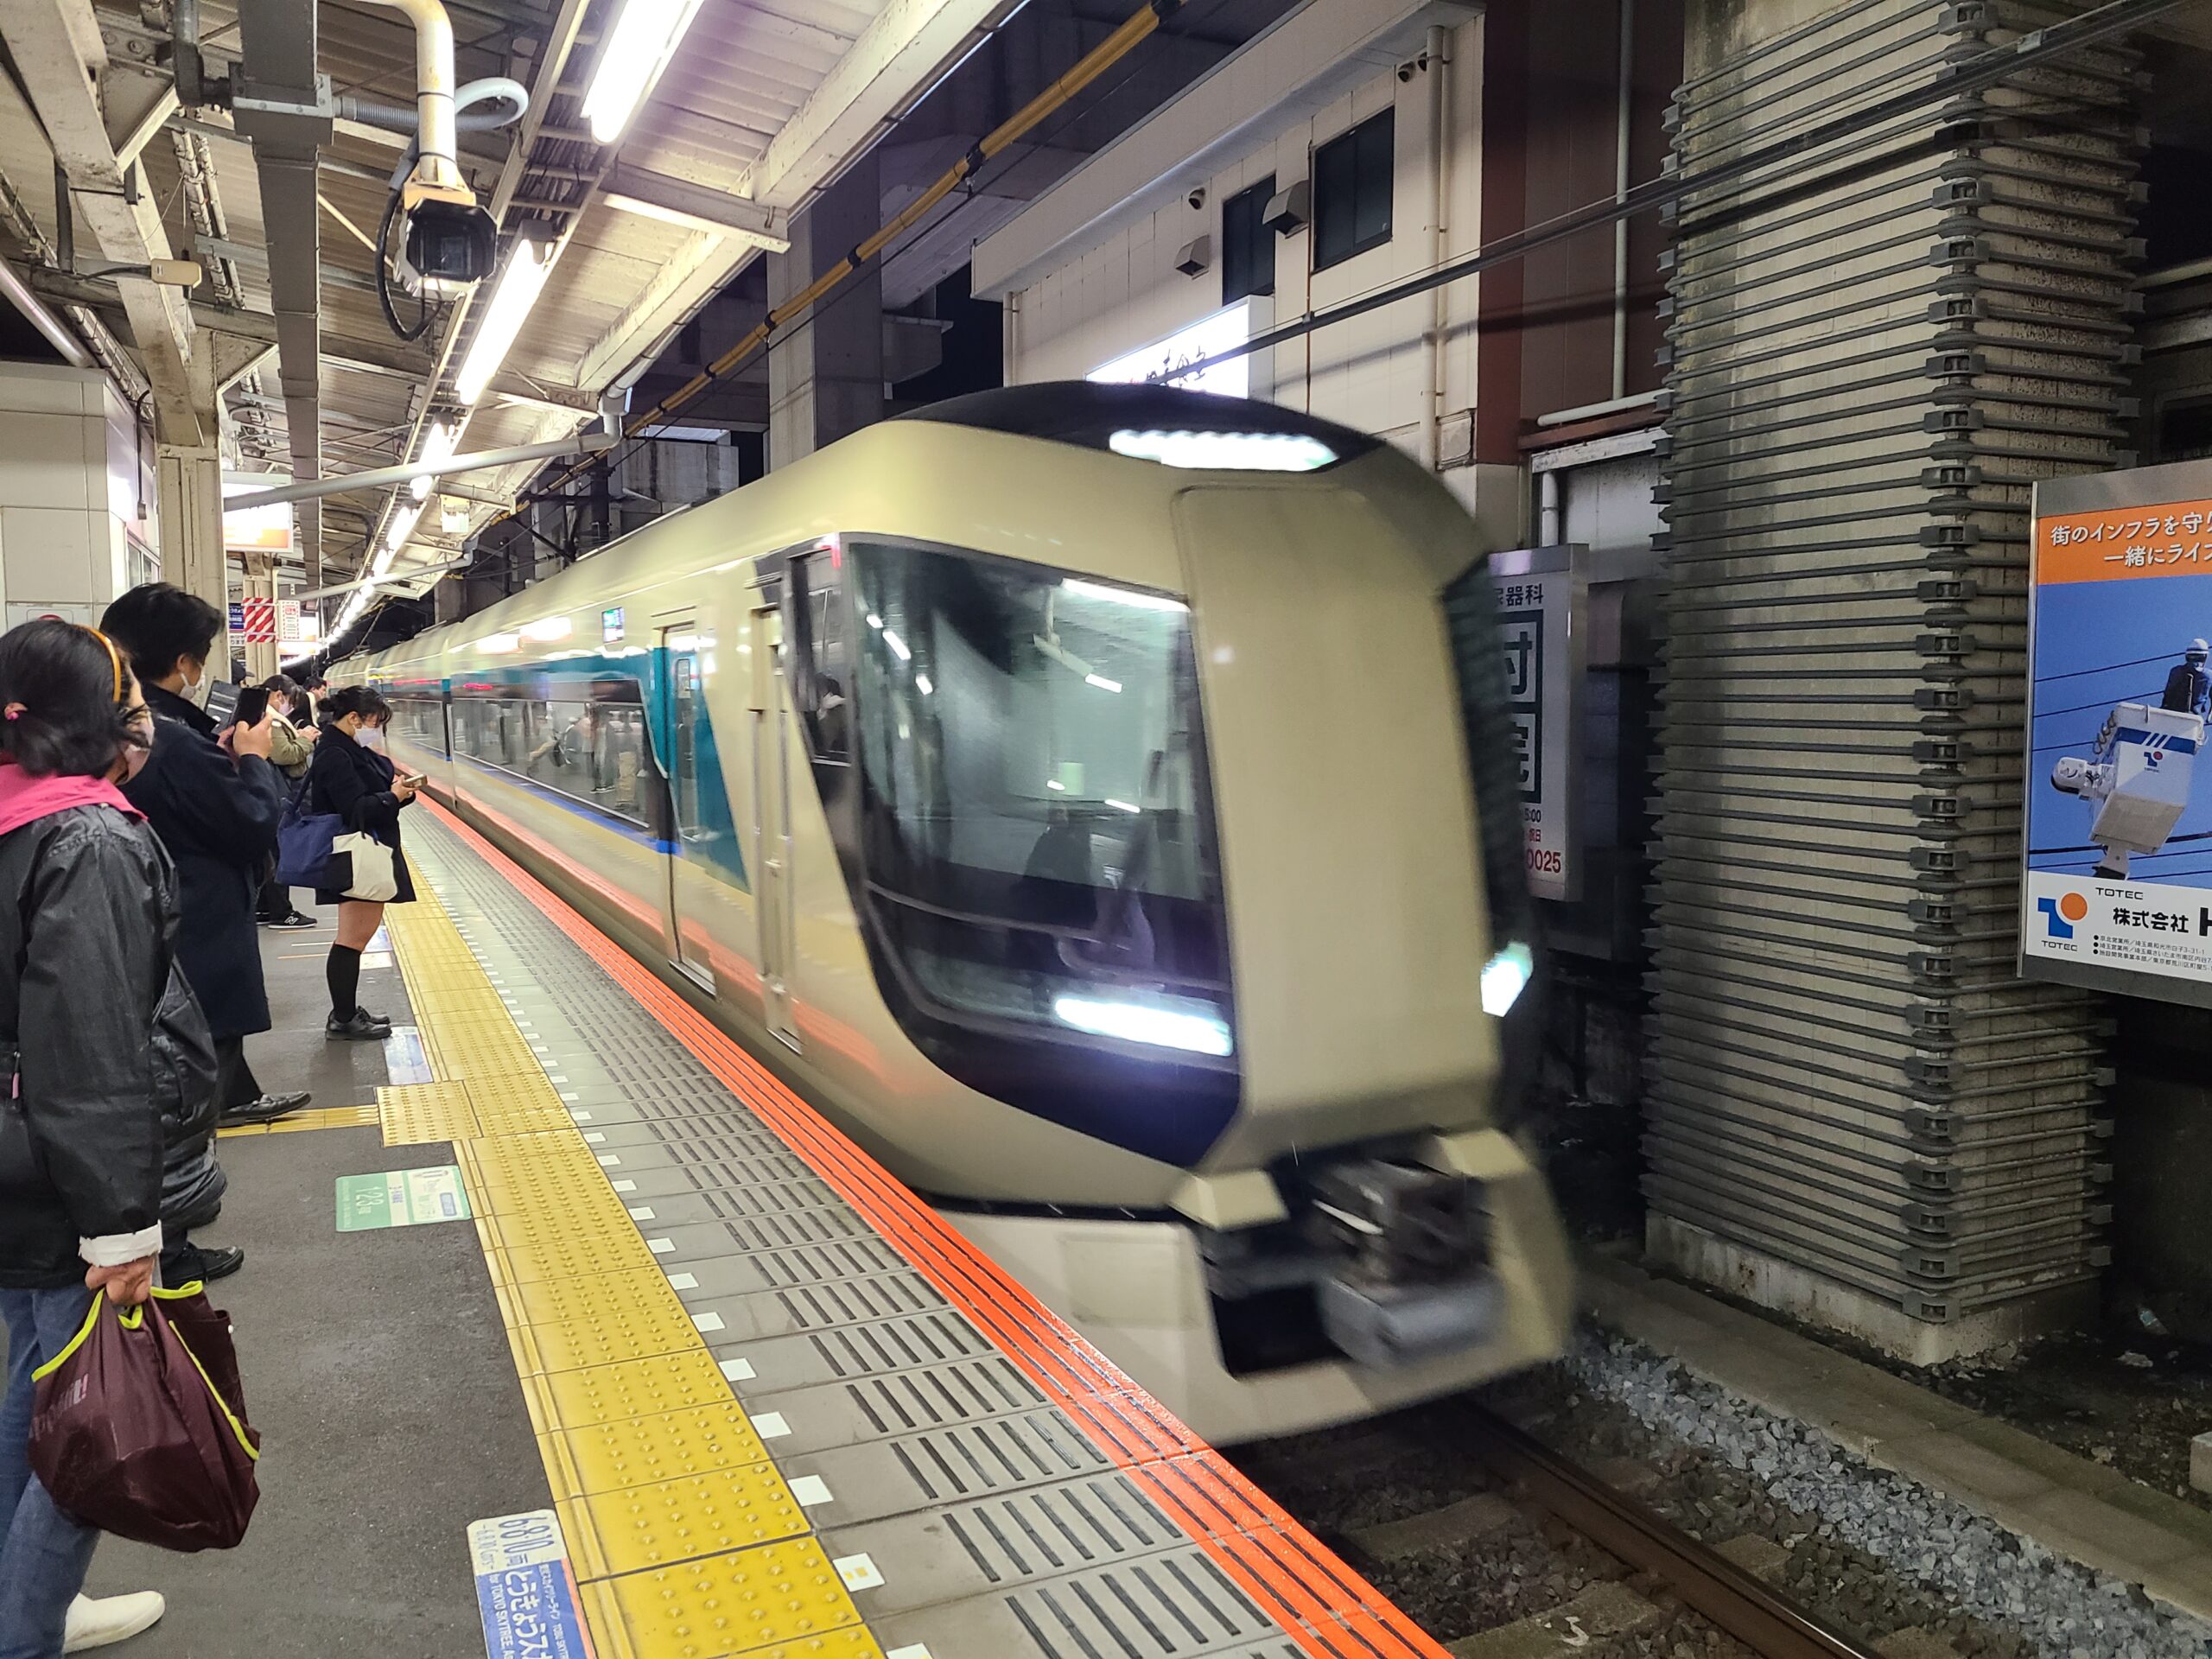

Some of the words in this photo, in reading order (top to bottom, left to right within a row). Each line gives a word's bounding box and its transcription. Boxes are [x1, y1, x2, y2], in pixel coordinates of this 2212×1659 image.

[2095, 887, 2144, 900] TOTEC
[2113, 907, 2190, 933] 株式会社
[2041, 940, 2078, 952] TOTEC
[491, 1583, 507, 1610] TOKYO
